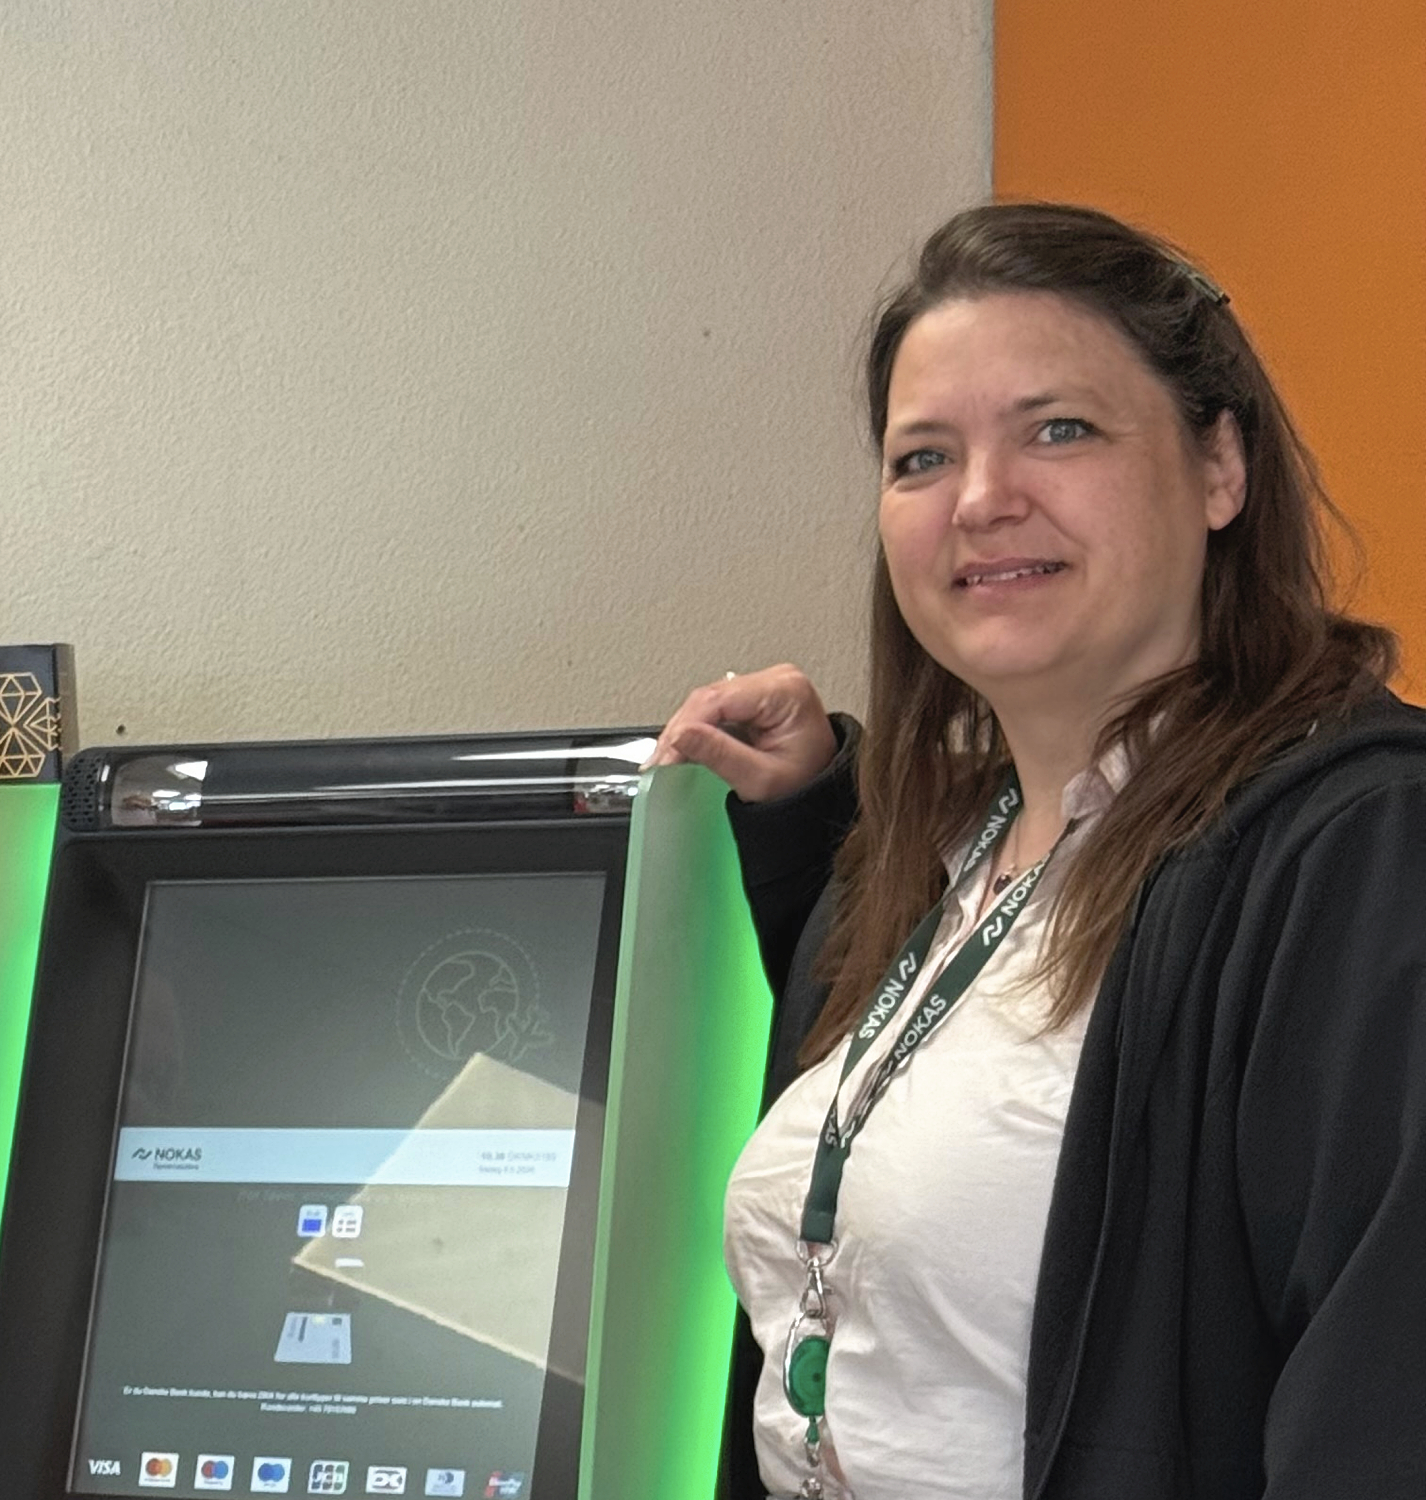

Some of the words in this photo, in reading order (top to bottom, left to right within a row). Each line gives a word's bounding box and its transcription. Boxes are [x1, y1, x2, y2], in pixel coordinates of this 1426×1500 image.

[858, 978, 905, 1039] NOKAS
[894, 994, 947, 1060] NOKAS
[155, 1147, 202, 1161] NOKAS
[88, 1458, 121, 1477] VISA
